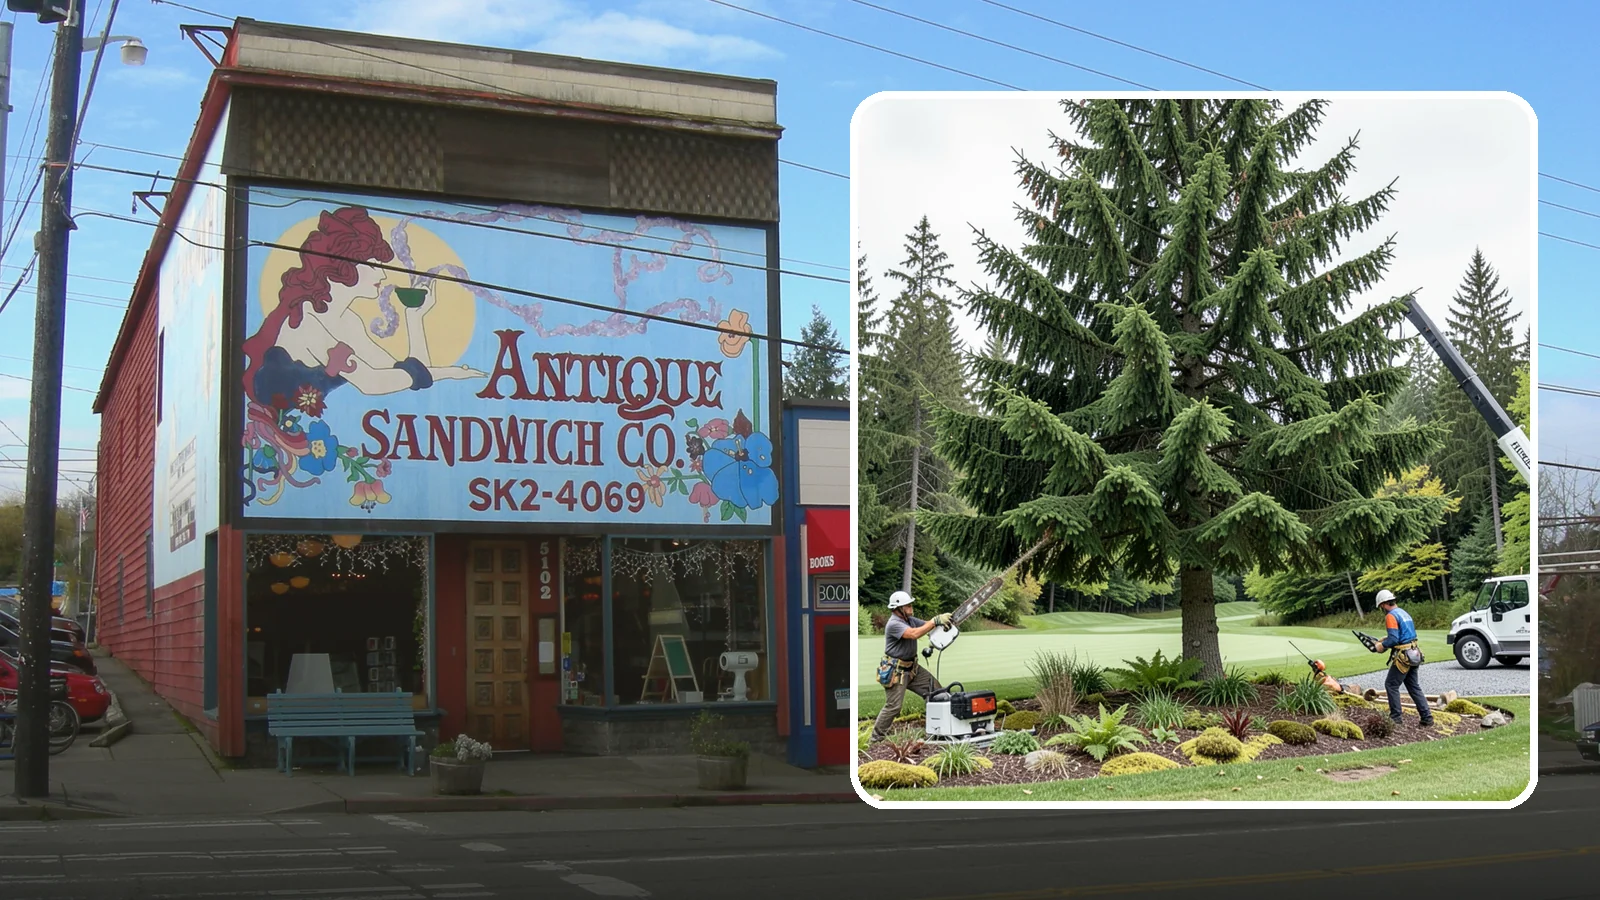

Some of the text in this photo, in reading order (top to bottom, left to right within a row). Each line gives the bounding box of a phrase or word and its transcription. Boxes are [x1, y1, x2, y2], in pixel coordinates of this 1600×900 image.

[476, 329, 723, 420] ANTIQUE
[361, 408, 685, 469] SANDWICH CO.
[468, 477, 645, 512] SK2-4069
[540, 542, 551, 599] 5102
[809, 555, 835, 569] BOOKS
